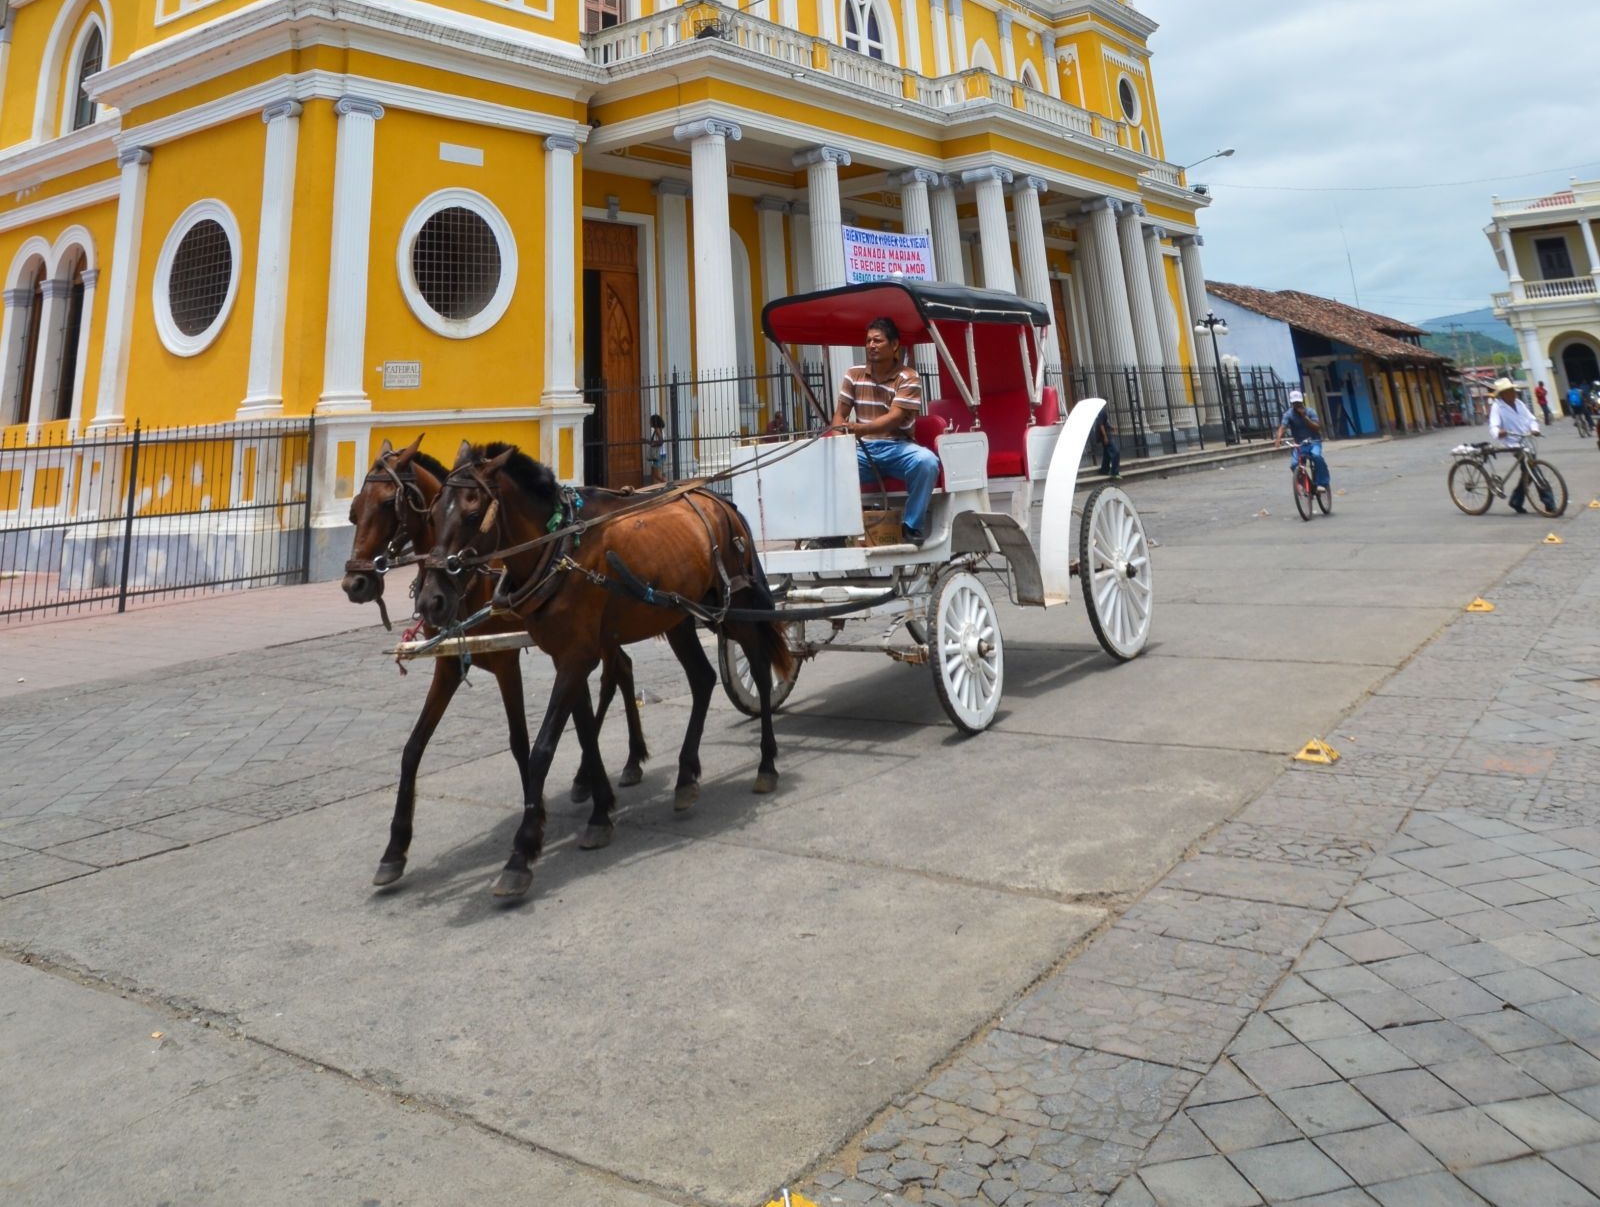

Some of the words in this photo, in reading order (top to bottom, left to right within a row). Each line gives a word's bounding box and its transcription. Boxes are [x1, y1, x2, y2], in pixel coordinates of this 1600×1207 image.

[879, 234, 899, 247] VIRGEN
[899, 236, 909, 248] DEL
[853, 245, 886, 259] GRANADA
[888, 249, 921, 261] MARIANA
[850, 258, 858, 269] TE
[860, 260, 885, 272] RECIBE
[888, 262, 902, 273] CON
[905, 263, 925, 274] AMOR
[387, 365, 418, 374] CATEDRAL
